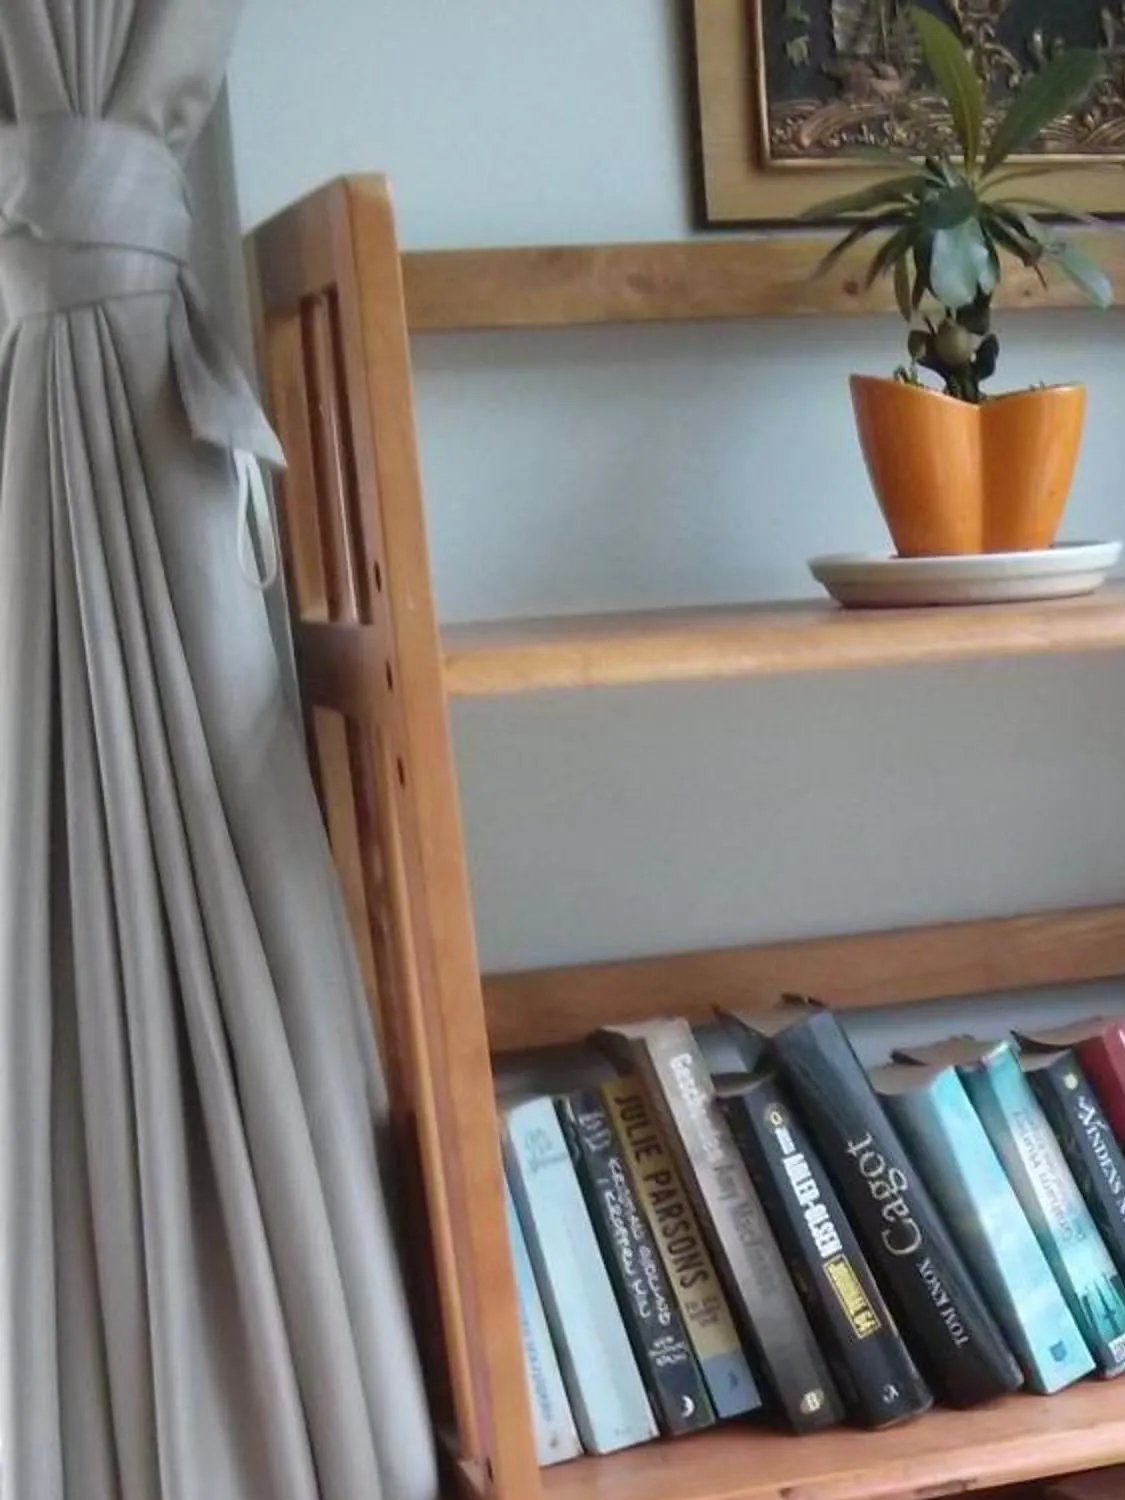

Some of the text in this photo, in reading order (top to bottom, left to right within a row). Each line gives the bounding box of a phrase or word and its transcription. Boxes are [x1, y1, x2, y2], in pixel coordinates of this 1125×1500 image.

[612, 1088, 661, 1163] JULIE
[639, 1166, 711, 1290] PARSONS
[778, 1150, 844, 1259] ADLER-OLSEN
[831, 1124, 972, 1348] TOM KNOX Cagot
